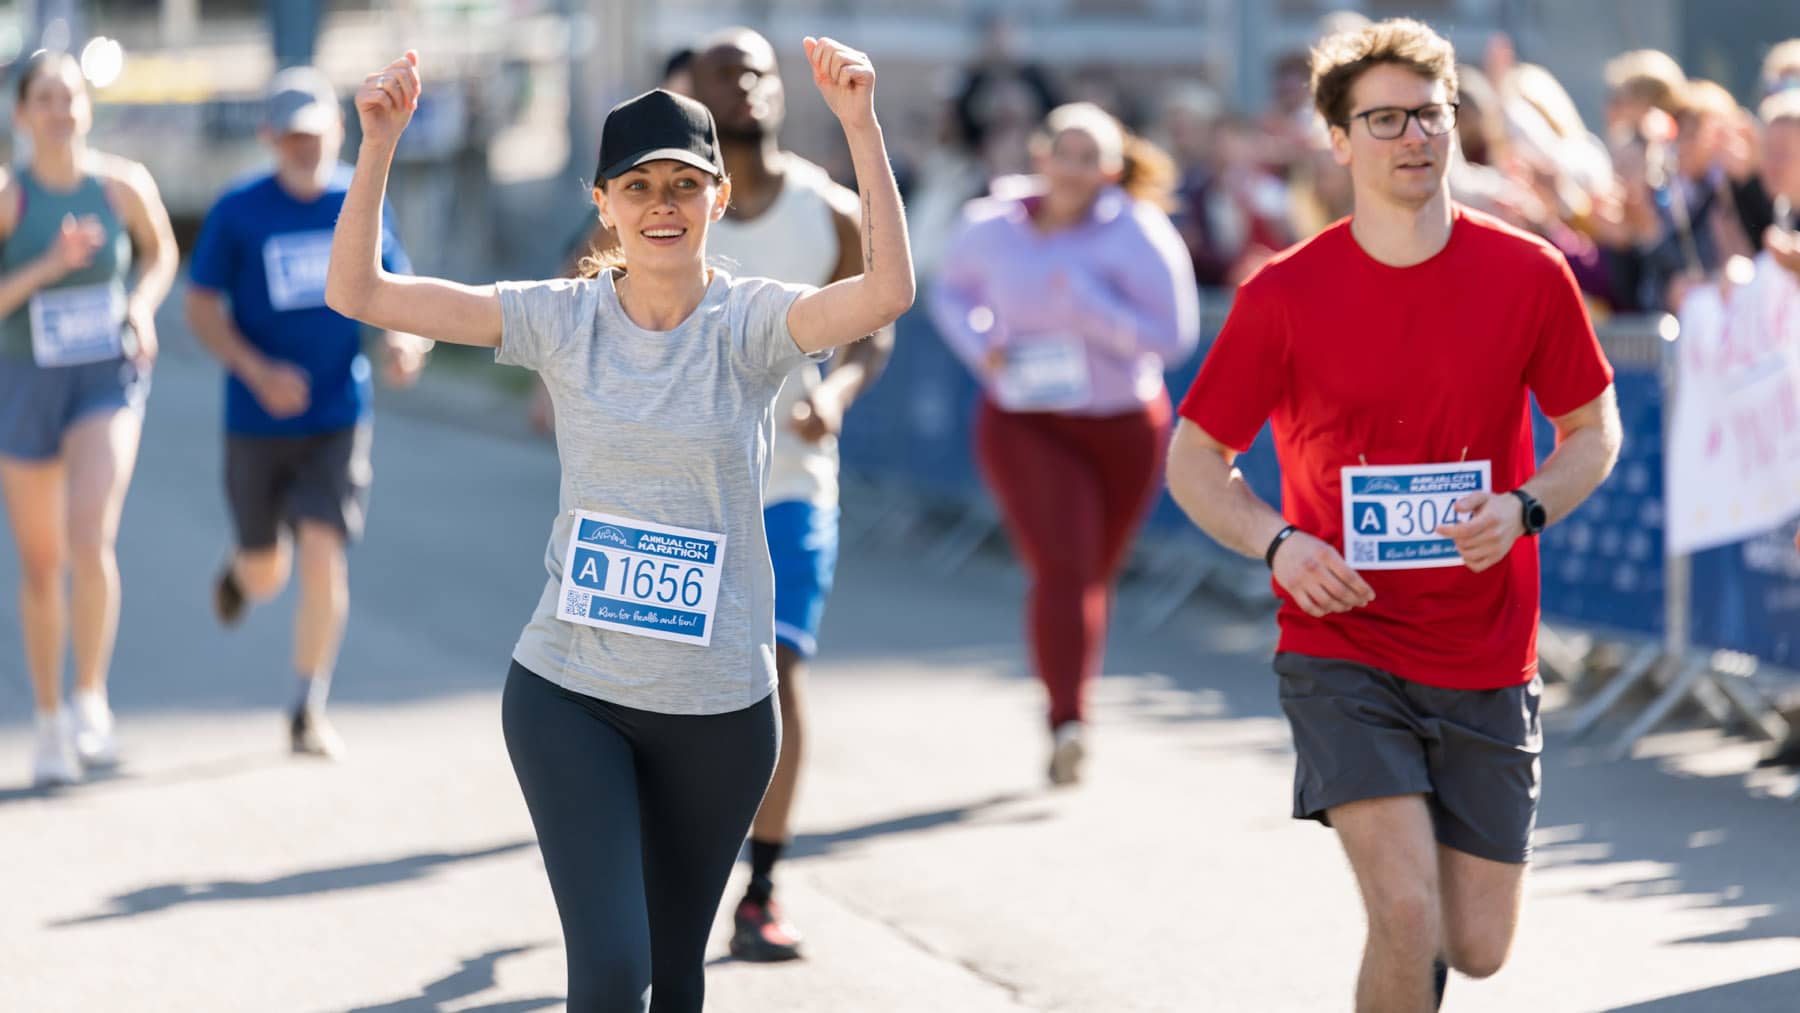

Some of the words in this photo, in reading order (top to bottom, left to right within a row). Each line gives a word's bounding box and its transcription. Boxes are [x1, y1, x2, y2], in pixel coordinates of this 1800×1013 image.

[1360, 506, 1381, 531] A
[1395, 498, 1474, 536] 304
[684, 541, 710, 551] CITY
[578, 557, 599, 583] A
[620, 556, 704, 607] 1656
[598, 607, 618, 618] Run
[618, 608, 631, 620] for
[633, 610, 659, 623] health
[659, 615, 677, 625] and
